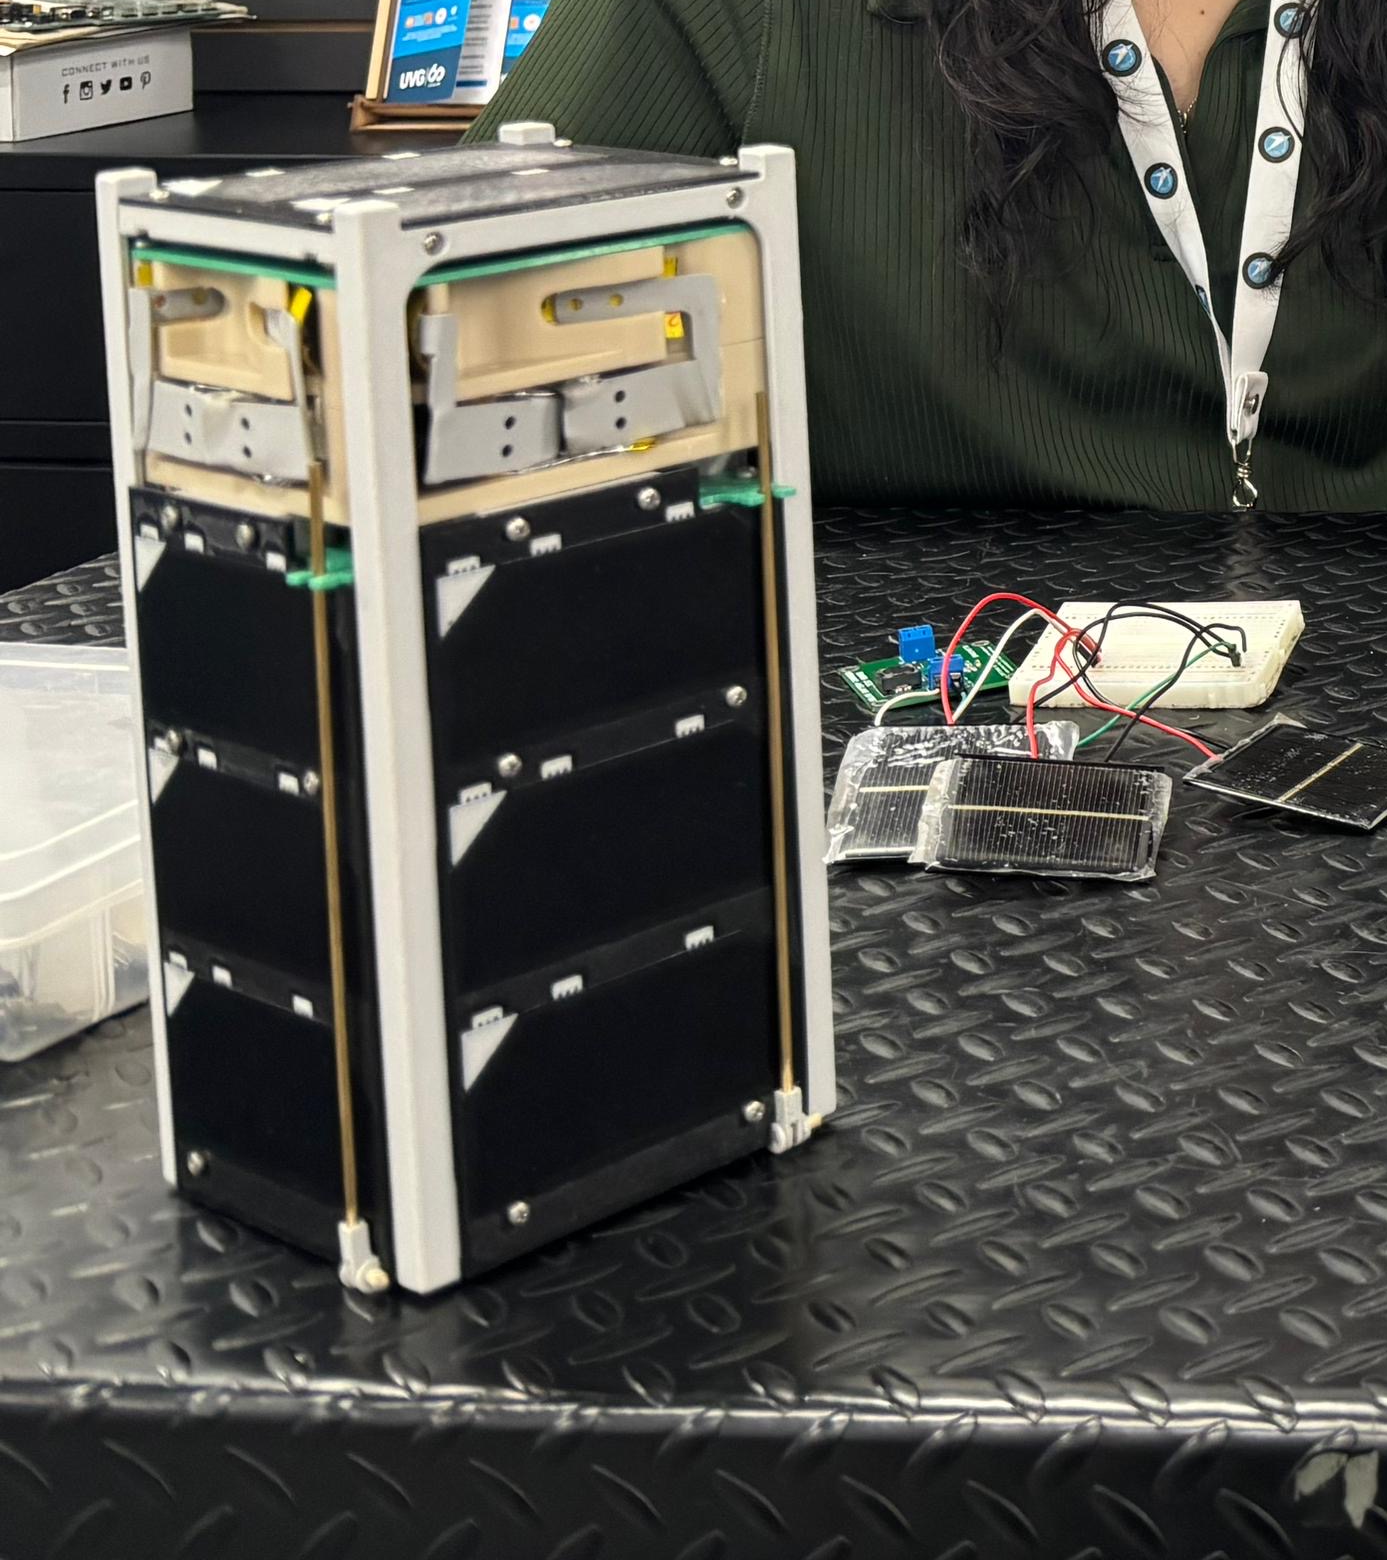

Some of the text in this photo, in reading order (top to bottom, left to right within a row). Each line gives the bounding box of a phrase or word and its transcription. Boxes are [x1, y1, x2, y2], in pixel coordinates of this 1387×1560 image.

[61, 55, 151, 77] CONNECT WITH US
[399, 69, 426, 90] UVG
